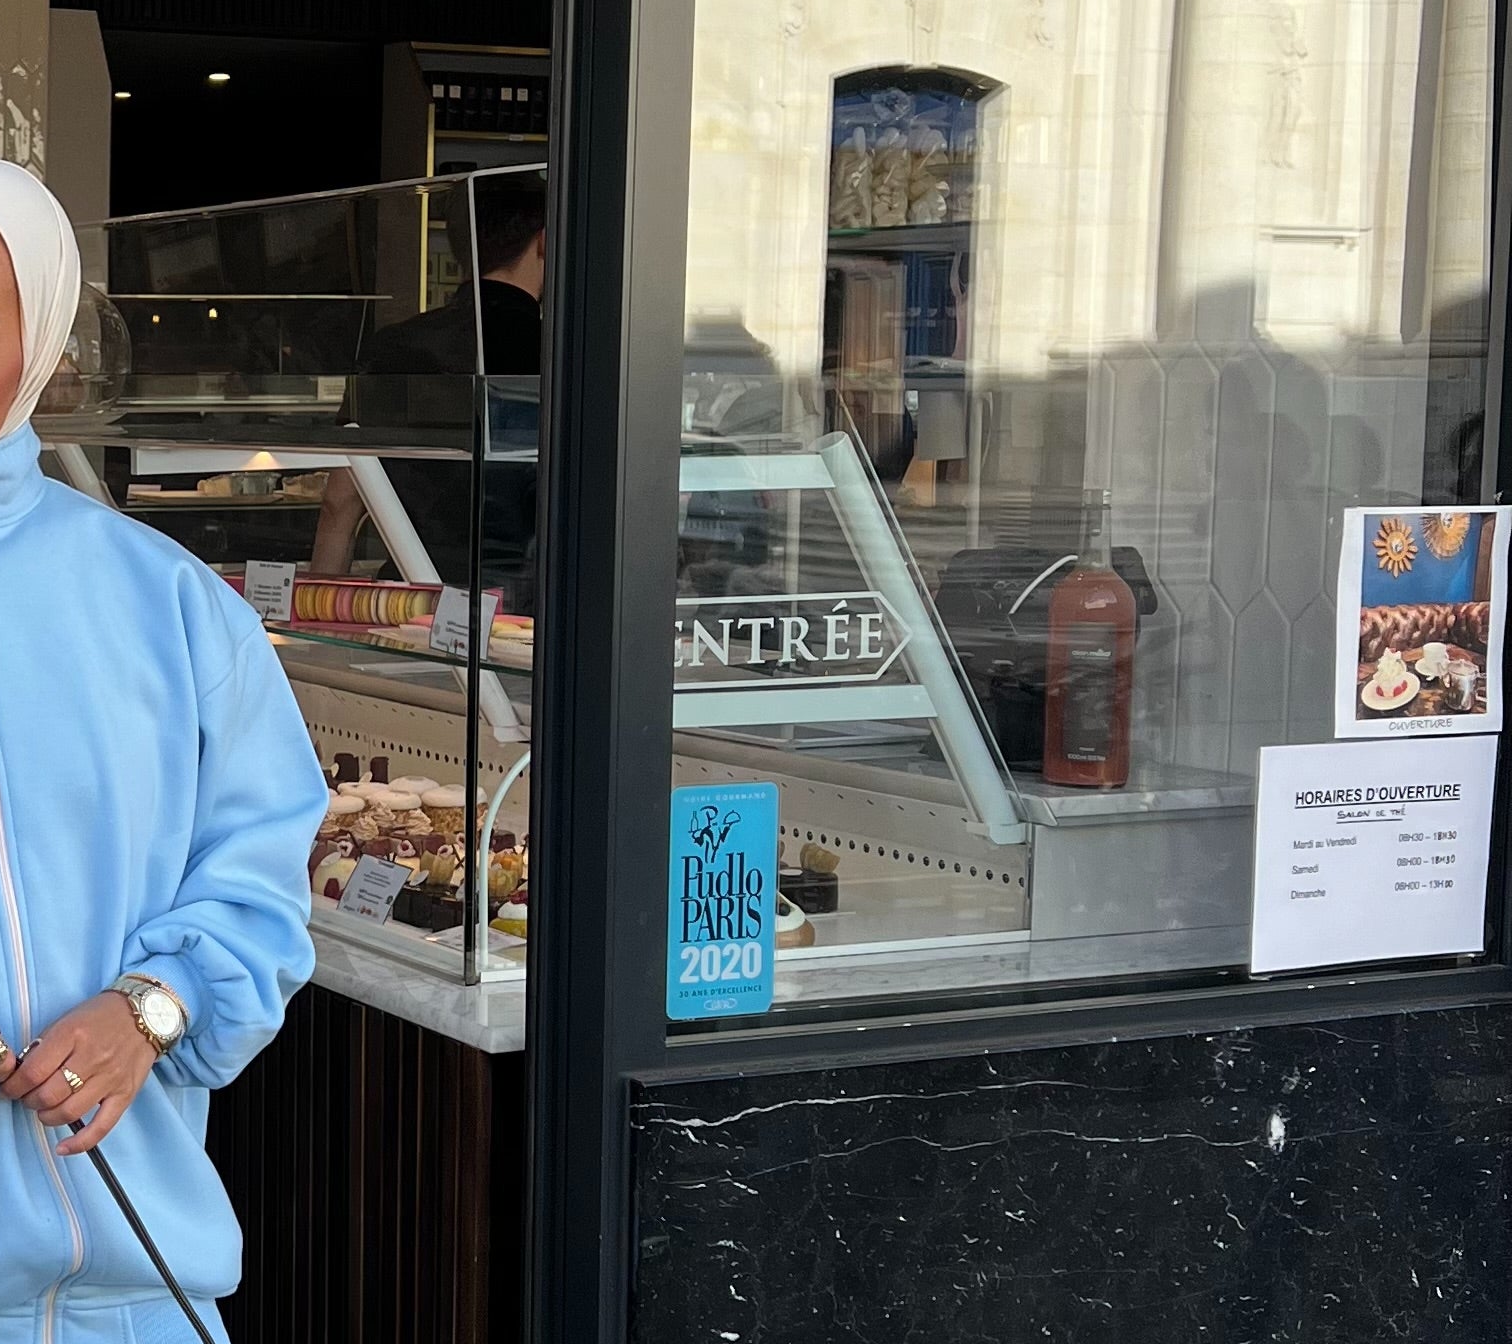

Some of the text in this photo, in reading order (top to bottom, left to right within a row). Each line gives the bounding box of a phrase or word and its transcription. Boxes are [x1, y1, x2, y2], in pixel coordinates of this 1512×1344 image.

[1388, 718, 1453, 731] OUVERTURE
[1295, 784, 1461, 806] HORAIRES D'OUVERTURE
[1337, 804, 1407, 820] SALON DE THÉ
[1293, 839, 1314, 849] Mardi
[1325, 836, 1358, 847] Vendredi
[681, 852, 763, 900] Pudlo
[1291, 864, 1319, 875] Samedi
[1290, 888, 1326, 900] Dimanche
[679, 895, 763, 944] PARIS
[679, 941, 763, 984] 2020
[710, 985, 763, 996] D'EXCELLENCE
